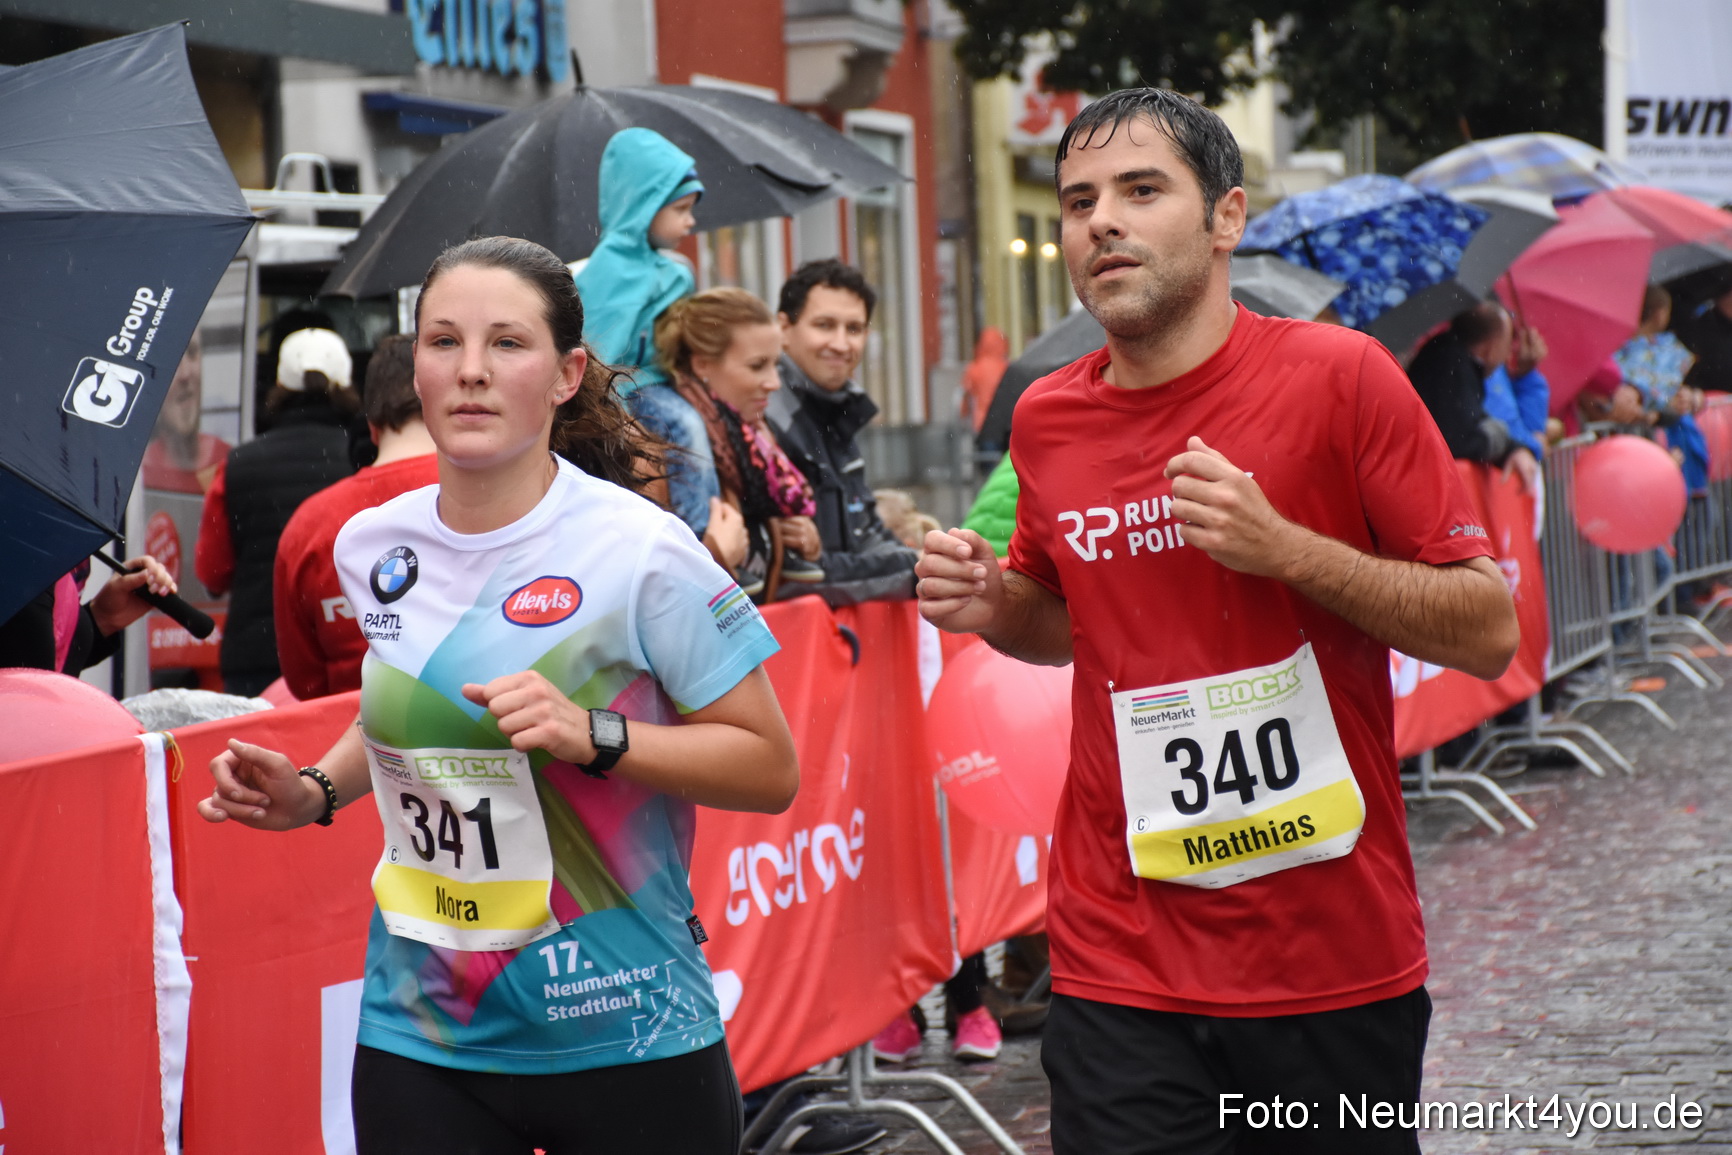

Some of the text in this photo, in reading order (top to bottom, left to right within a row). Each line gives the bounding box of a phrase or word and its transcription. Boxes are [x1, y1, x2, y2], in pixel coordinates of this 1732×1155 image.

[106, 287, 158, 356] Group
[136, 341, 151, 361] YOUR
[151, 309, 164, 326] OUR
[158, 286, 174, 310] WORK
[379, 547, 417, 568] BMW
[511, 588, 572, 613] Hervis
[364, 613, 402, 629] PARTL
[364, 629, 400, 641] Neumarkt
[1206, 661, 1301, 711] BOCK
[1130, 707, 1196, 727] NeuerMarkt
[1210, 708, 1238, 720] inspired
[1239, 706, 1249, 716] by
[1250, 701, 1275, 713] smart
[414, 756, 514, 780] BOCK
[462, 779, 484, 787] smart
[1164, 717, 1300, 816] 340
[400, 792, 500, 870] 341
[1182, 814, 1316, 866] Matthias
[435, 886, 479, 922] Nora
[538, 941, 593, 977] 17.
[543, 964, 658, 999] Neumarkter
[546, 989, 641, 1021] Stadtlauf
[643, 1005, 673, 1048] September
